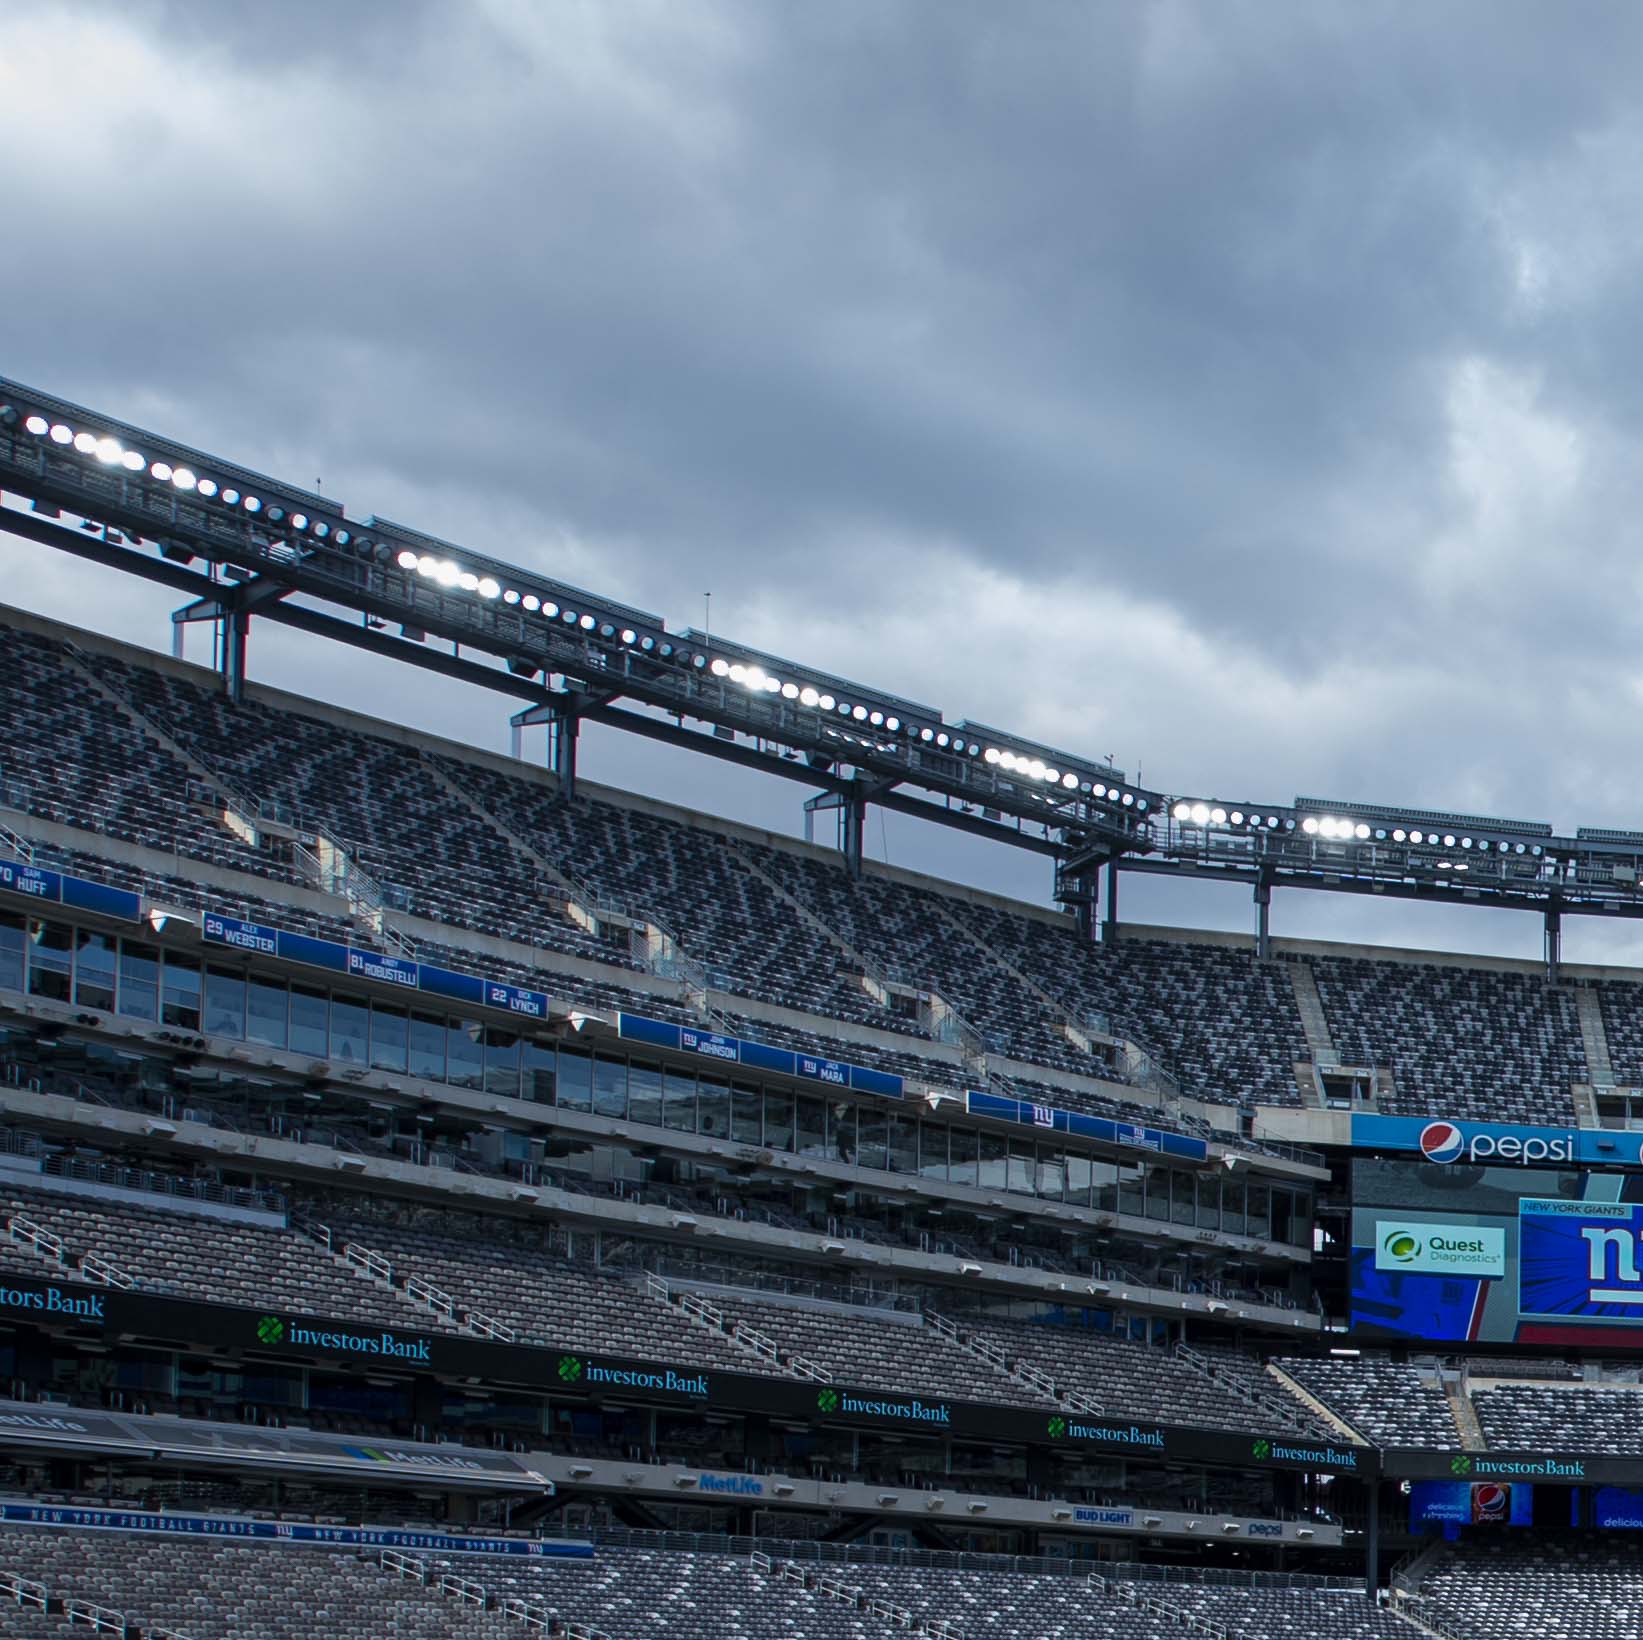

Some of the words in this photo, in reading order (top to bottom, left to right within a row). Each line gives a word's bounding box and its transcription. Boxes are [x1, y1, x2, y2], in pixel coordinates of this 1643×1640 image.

[17, 876, 48, 896] HUFF
[206, 919, 223, 935] 29
[225, 929, 275, 952] WEBSTER
[351, 954, 365, 970] 81
[364, 962, 416, 985] ROBUSTELLI
[492, 988, 507, 1002] 22
[510, 997, 539, 1015] LYNCH
[684, 1032, 697, 1048] ny
[698, 1041, 737, 1061] JOHNSON
[820, 1068, 844, 1084] MARA
[1033, 1105, 1054, 1128] ny
[1470, 1134, 1574, 1165] pepsi
[1524, 1203, 1552, 1212] NEW
[1553, 1204, 1582, 1213] YORK
[1583, 1206, 1625, 1216] GIANTS
[1429, 1236, 1484, 1256] Quest
[1429, 1251, 1500, 1265] Diagnostics
[290, 1322, 430, 1360] investorsBank
[586, 1361, 709, 1395] investorsBank
[842, 1392, 950, 1423] investorsBank
[1069, 1420, 1165, 1448] investorsBank
[1272, 1441, 1356, 1467] investorsBank
[1475, 1458, 1585, 1478] investorsBank
[700, 1473, 763, 1495] MetLife
[1076, 1511, 1098, 1521] BUD
[1100, 1512, 1131, 1524] LIGHT
[276, 1524, 293, 1540] ny
[1249, 1523, 1282, 1537] pepsi
